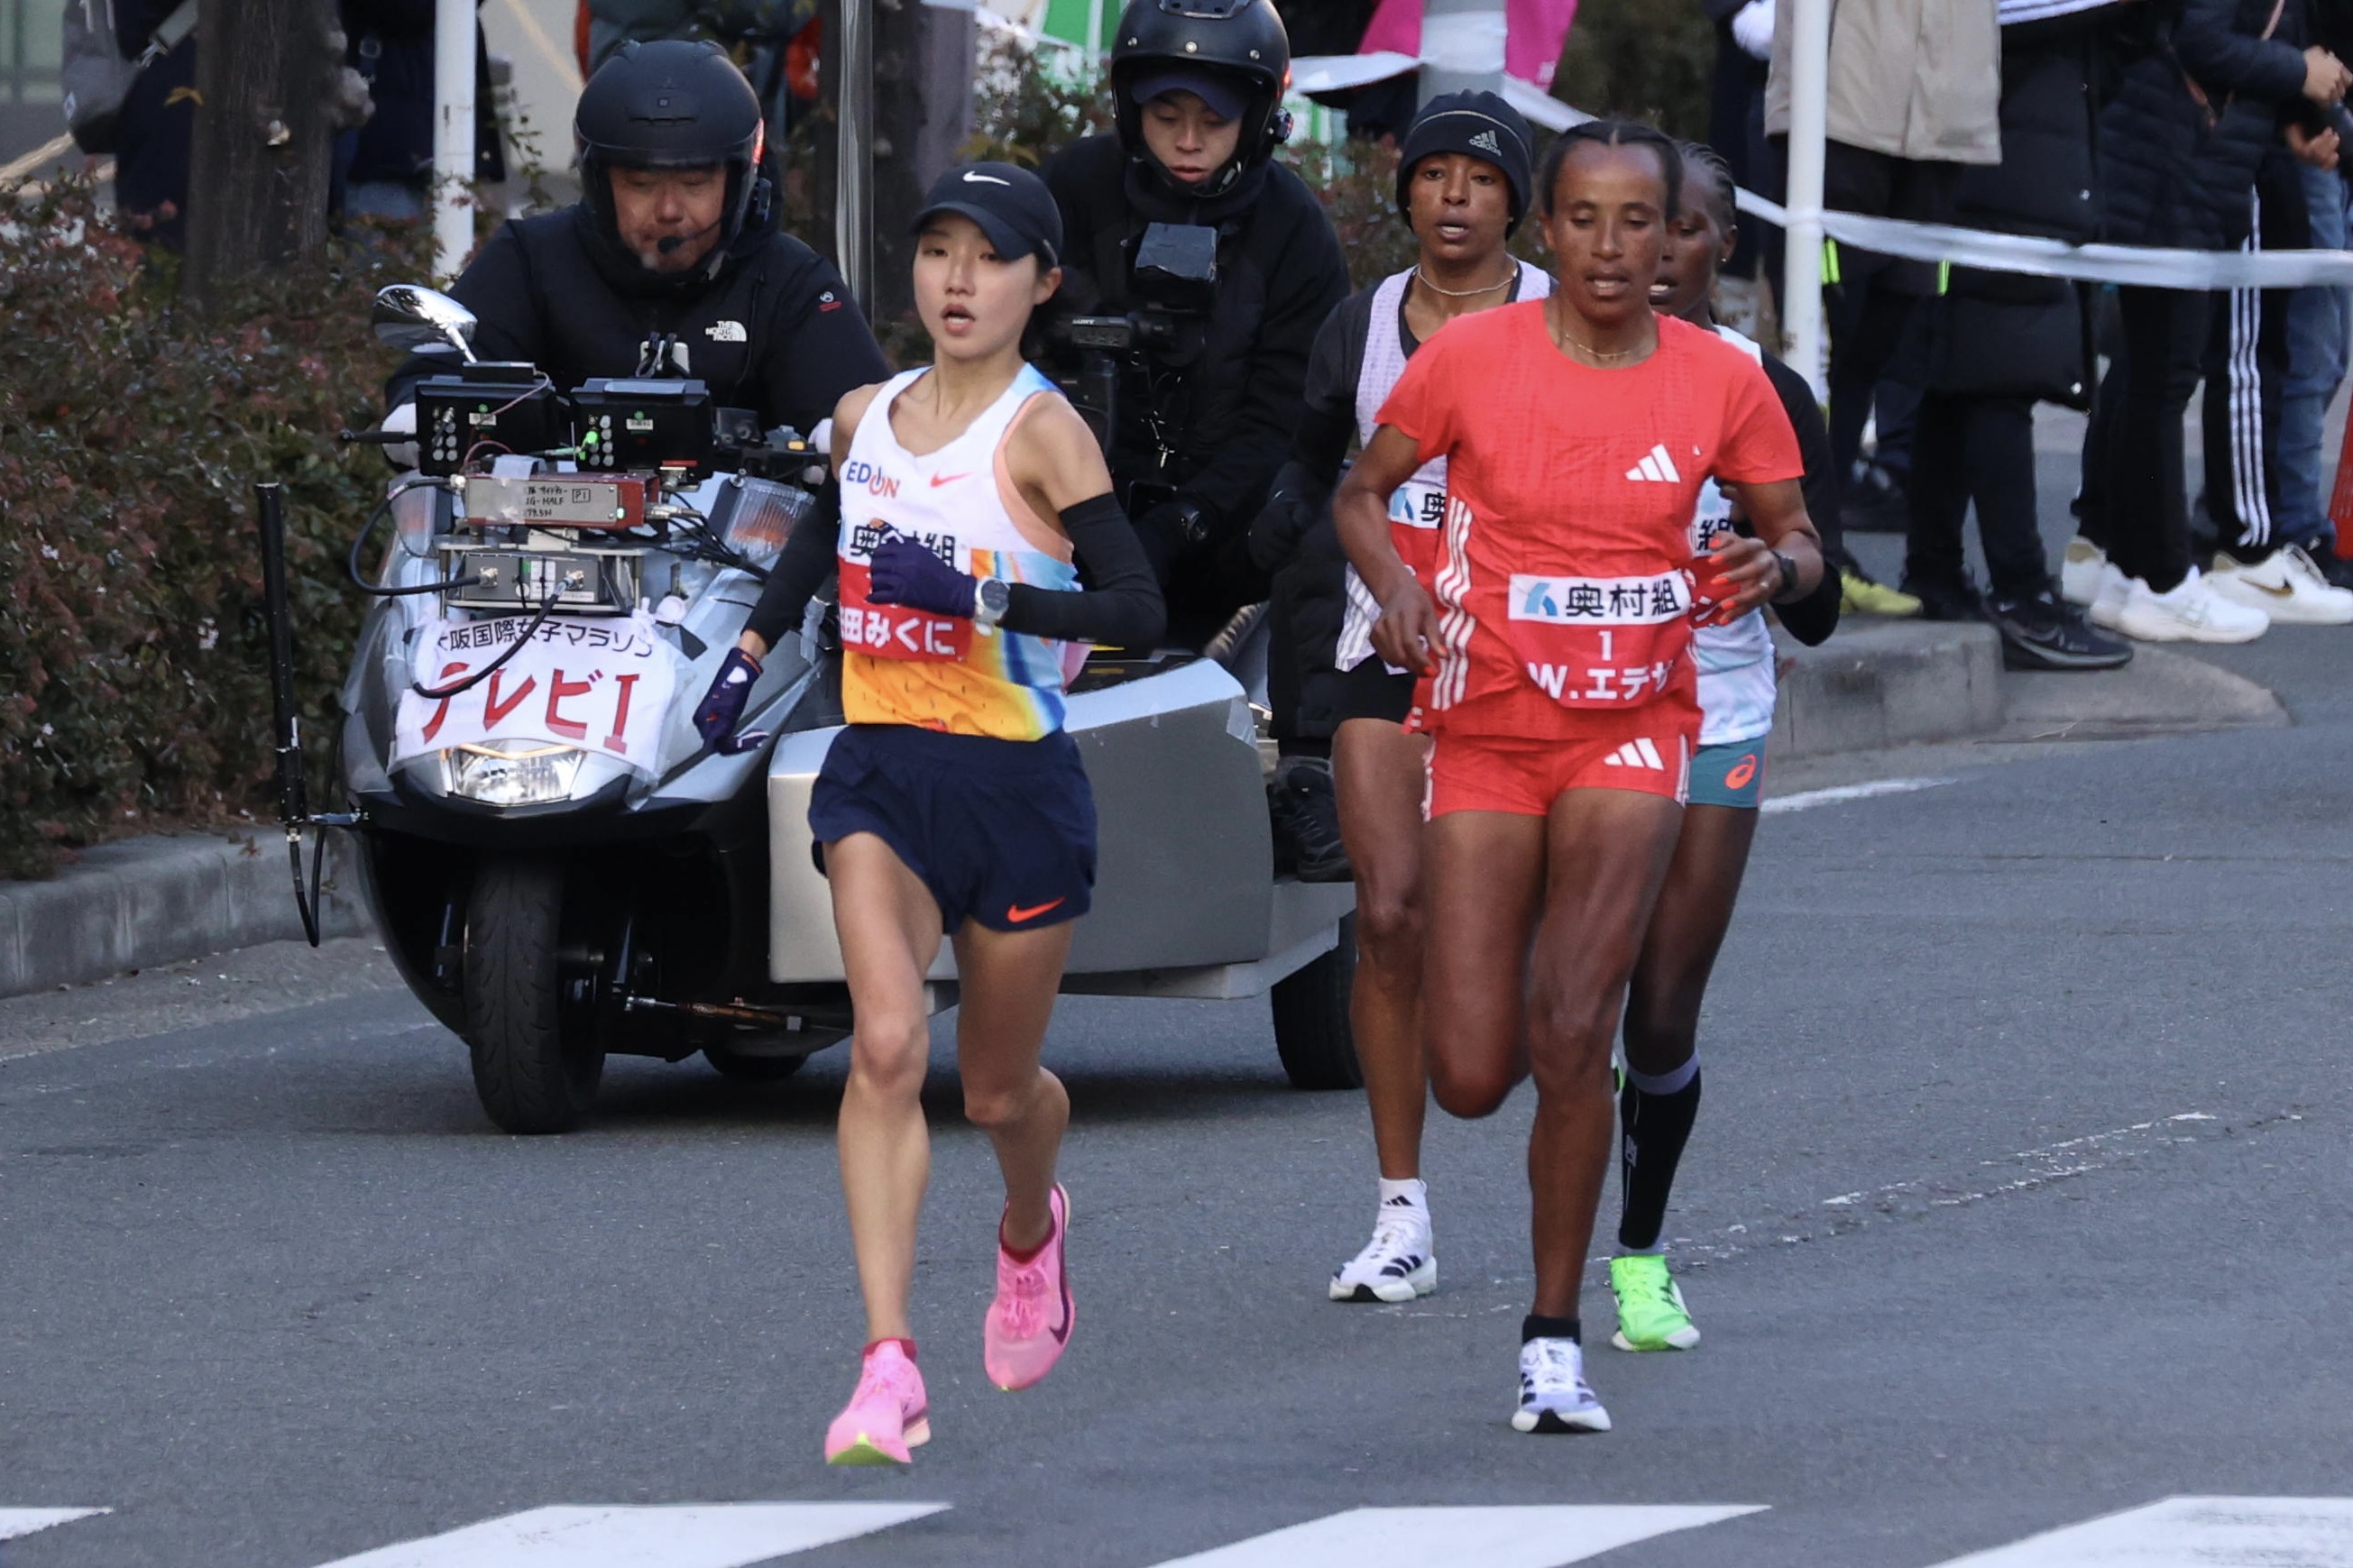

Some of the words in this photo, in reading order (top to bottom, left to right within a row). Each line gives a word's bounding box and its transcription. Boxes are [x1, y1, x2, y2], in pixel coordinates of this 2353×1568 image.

[1469, 138, 1502, 157] adidas
[705, 326, 731, 335] NORTH
[717, 320, 732, 328] THE
[712, 334, 732, 342] FACE
[846, 462, 900, 498] EDION
[1566, 579, 1681, 618] 奥村組
[1598, 630, 1612, 661] 1
